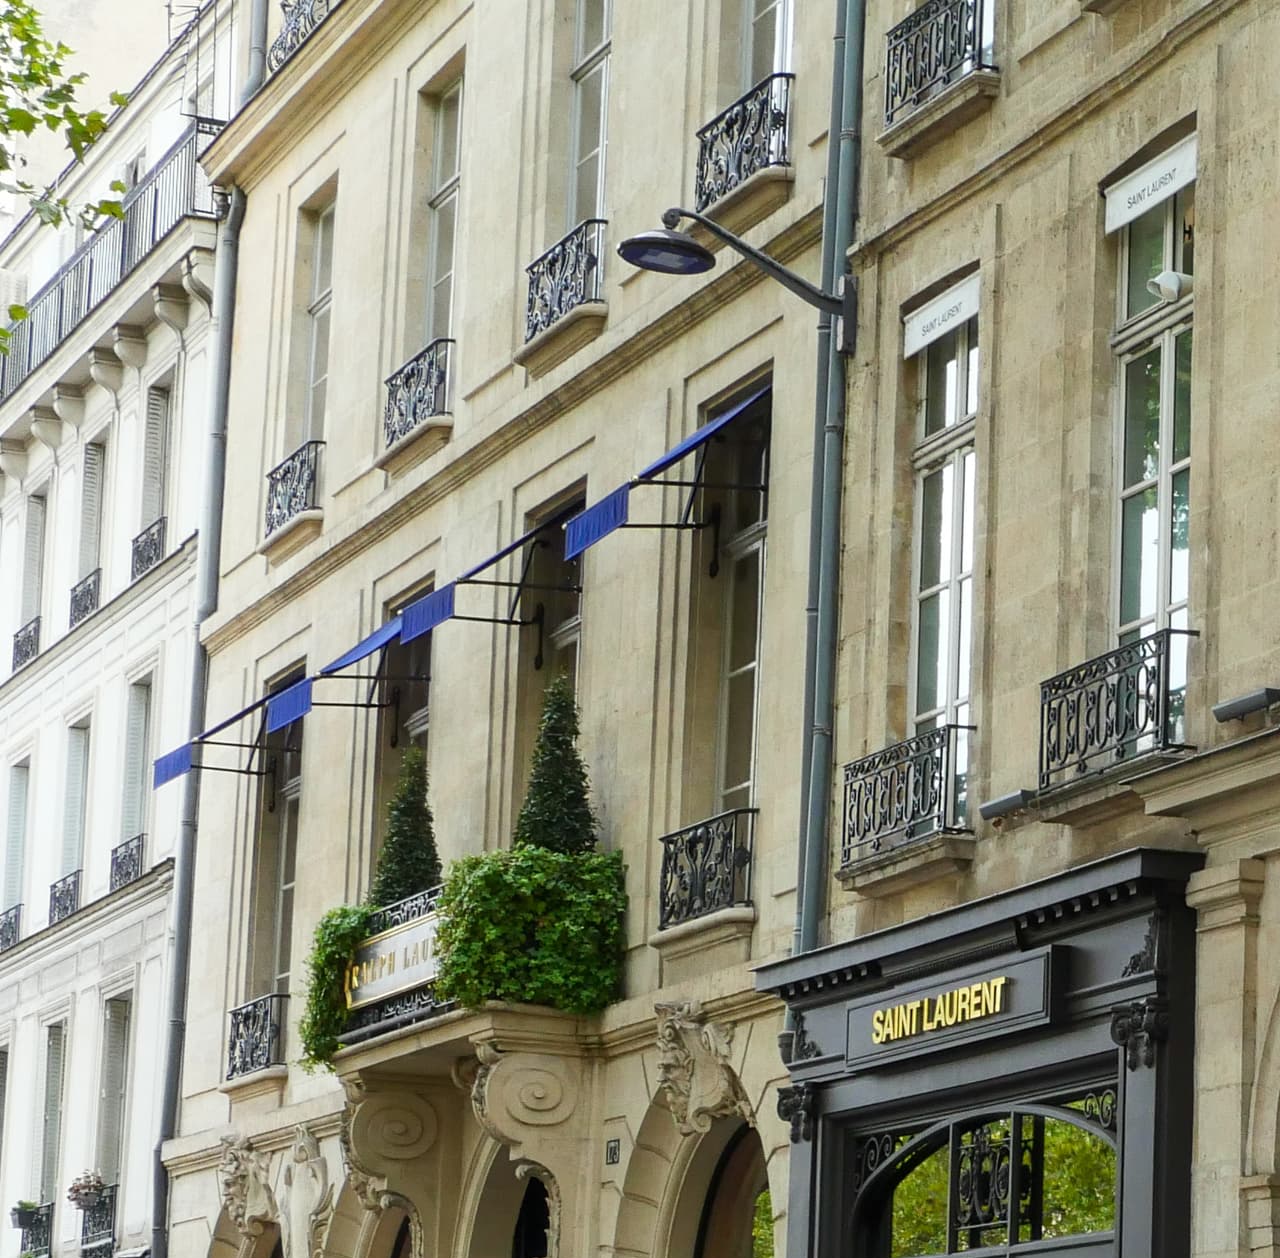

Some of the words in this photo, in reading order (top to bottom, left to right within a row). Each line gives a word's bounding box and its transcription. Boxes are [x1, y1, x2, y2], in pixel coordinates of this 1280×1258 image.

[1127, 188, 1146, 209] SAINT
[1147, 168, 1177, 197] LAURENT
[872, 1000, 921, 1044] SAINT
[922, 976, 1006, 1032] LAURENT
